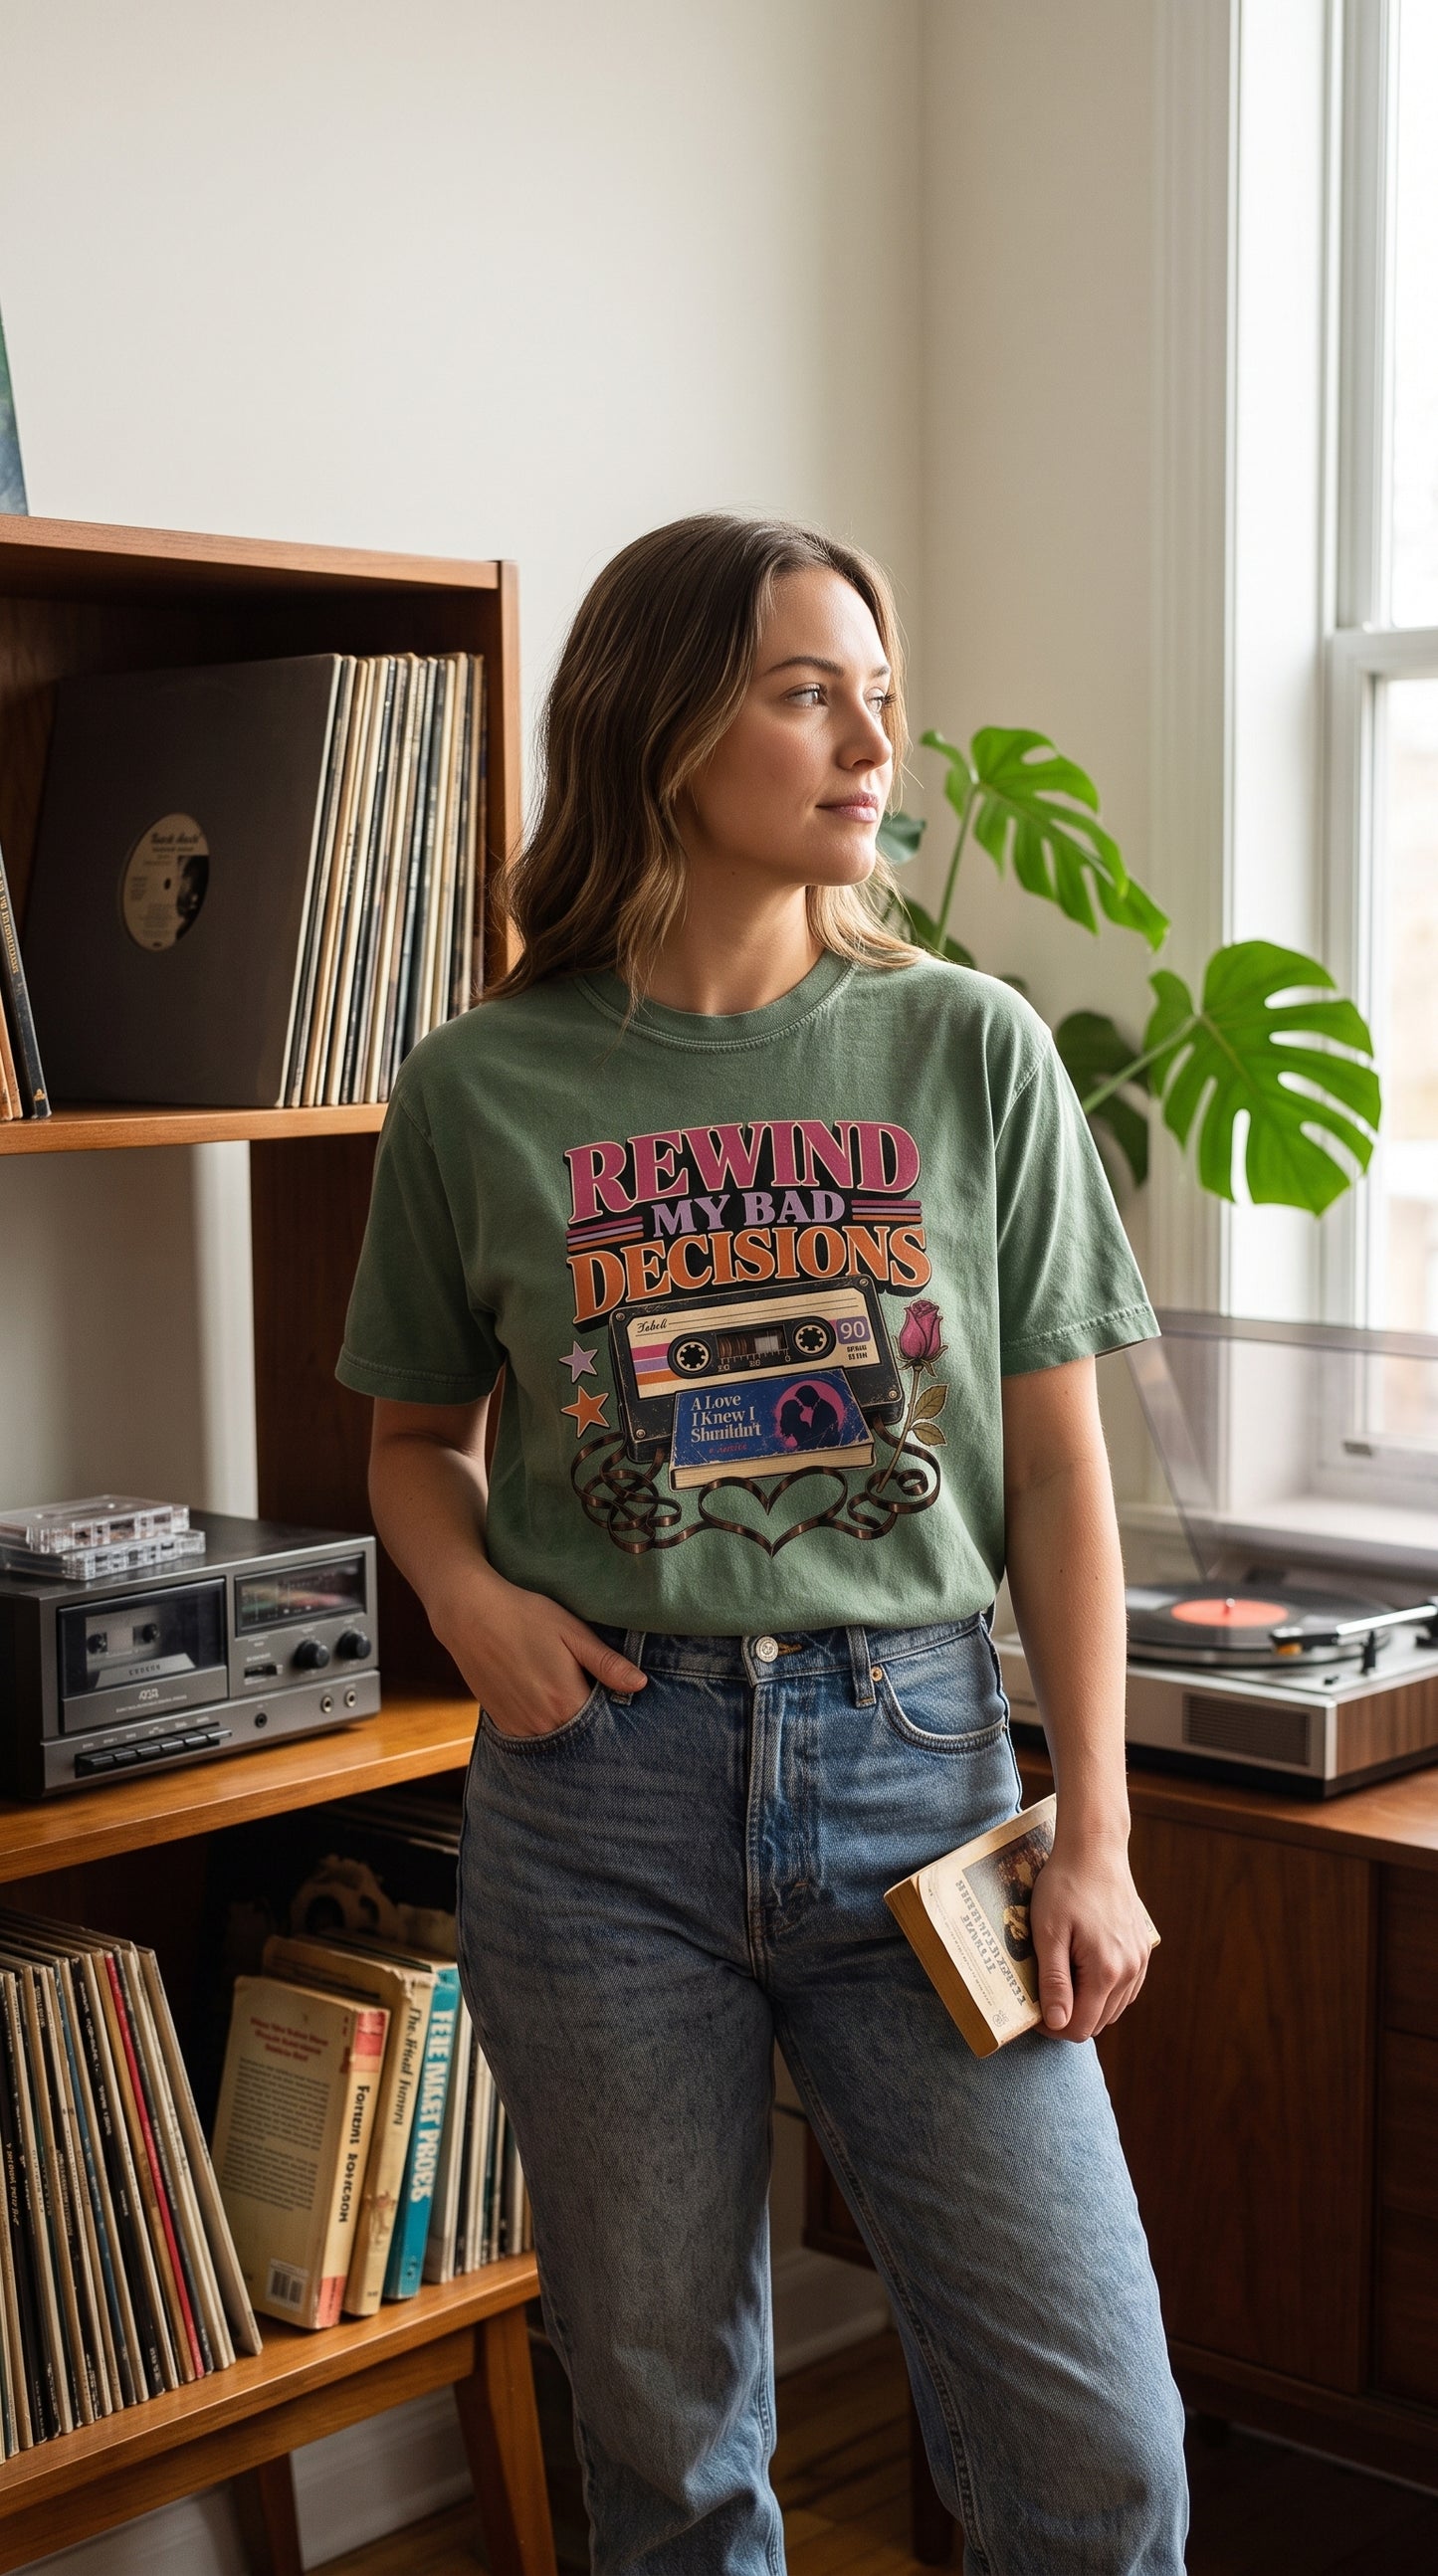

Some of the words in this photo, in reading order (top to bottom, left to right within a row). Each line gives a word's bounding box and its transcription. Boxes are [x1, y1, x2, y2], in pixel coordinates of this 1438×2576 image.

[564, 1119, 922, 1225] REWIND
[651, 1194, 730, 1238] MY
[743, 1190, 846, 1225] BAD
[566, 1226, 932, 1324] DECISIONS
[840, 1319, 866, 1340] 90
[691, 1396, 702, 1411] A
[706, 1393, 741, 1410] Love
[692, 1413, 699, 1427] I
[700, 1409, 745, 1427] Knew
[749, 1406, 755, 1421] I
